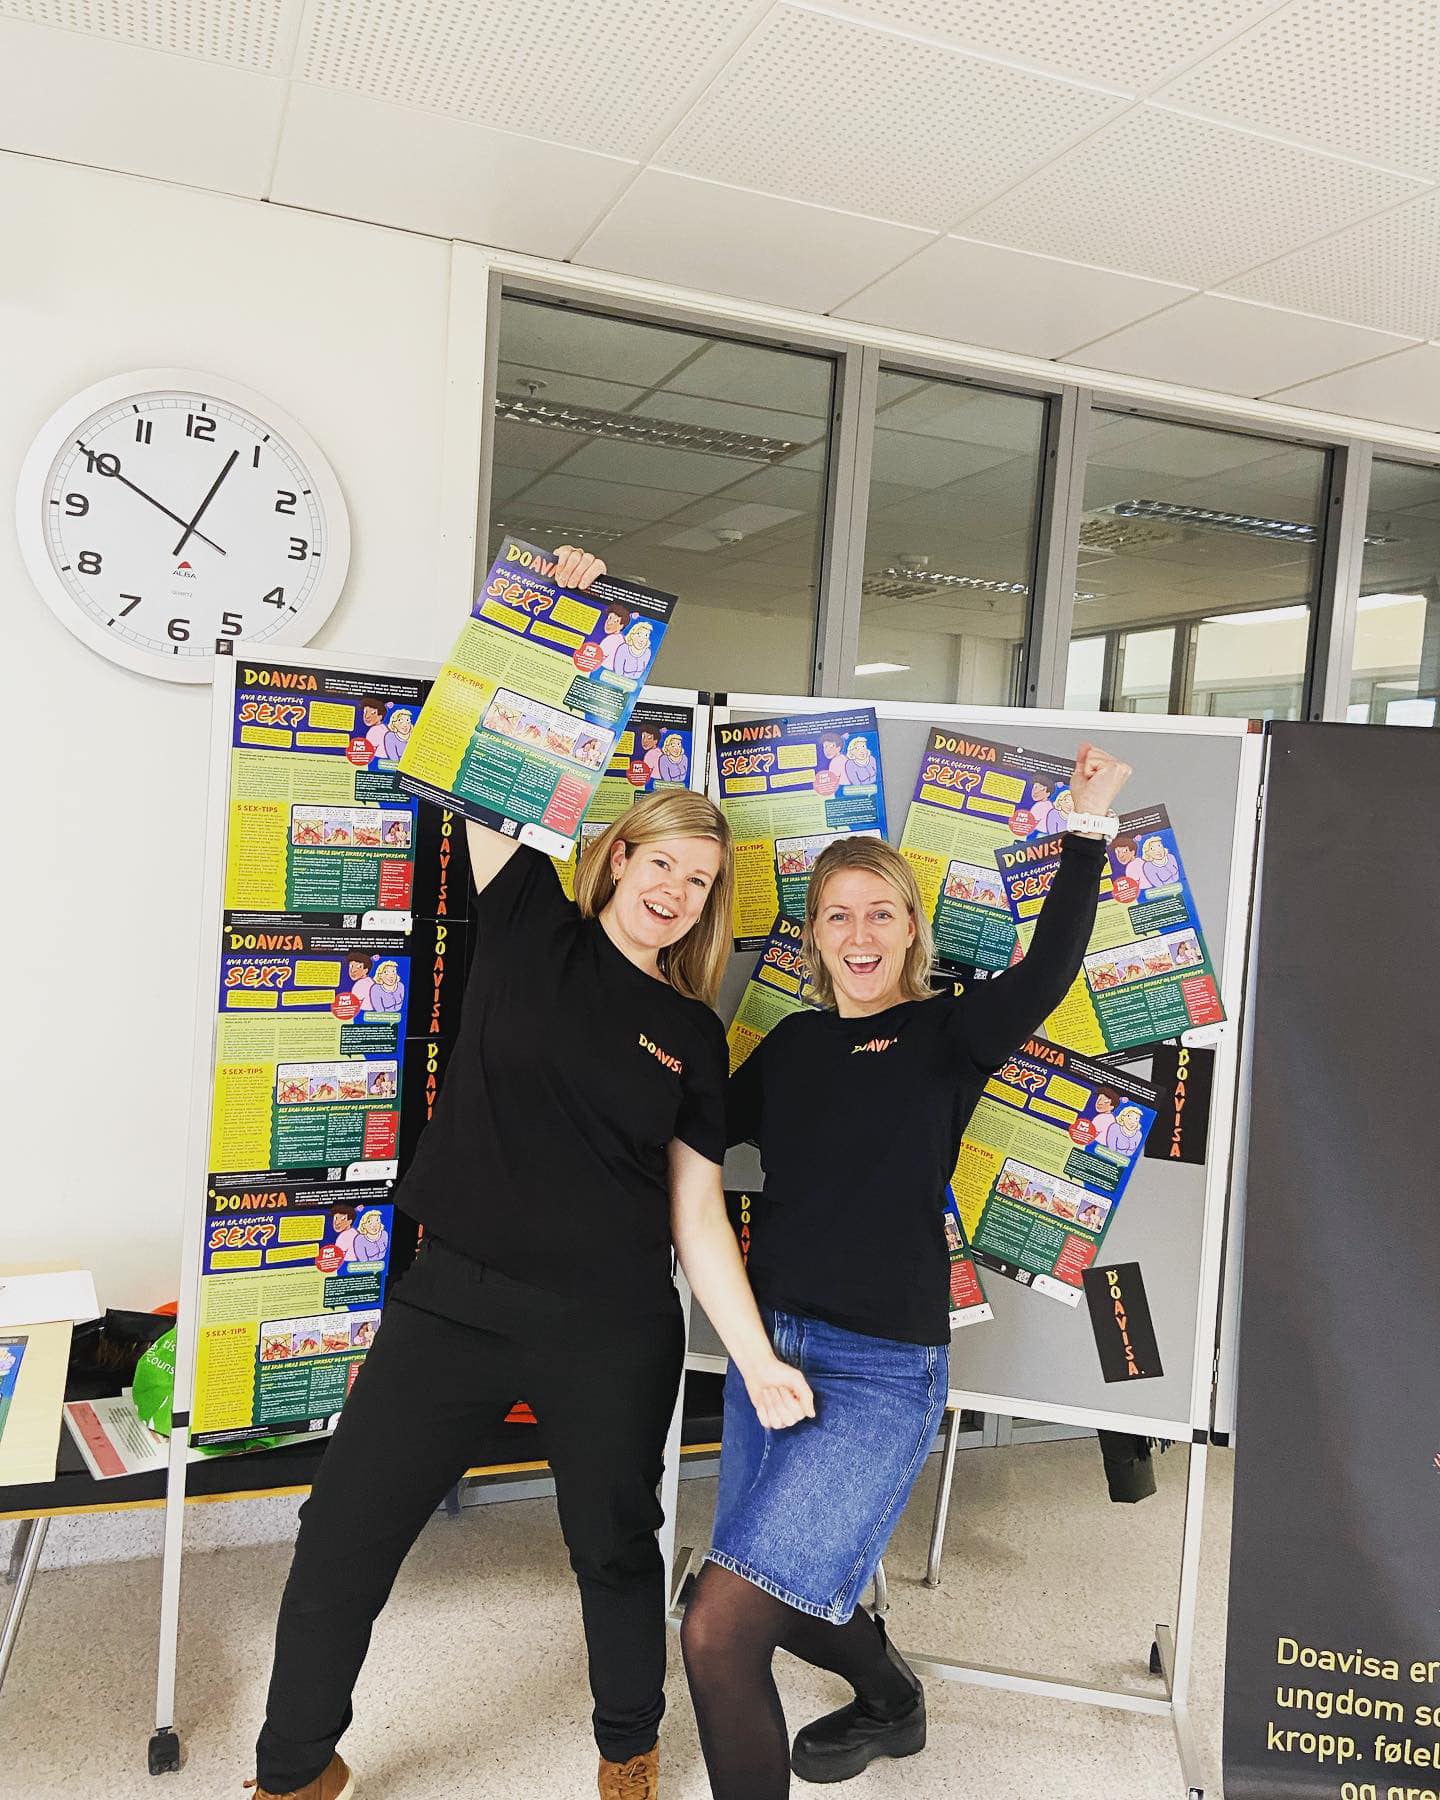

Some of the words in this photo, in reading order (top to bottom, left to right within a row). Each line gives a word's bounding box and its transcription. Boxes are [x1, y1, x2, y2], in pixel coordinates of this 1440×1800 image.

[136, 419, 153, 445] 11
[186, 414, 217, 443] 12
[86, 450, 122, 478] 10
[253, 445, 261, 468] 1
[65, 493, 90, 517] 9
[275, 490, 298, 515] 2
[288, 537, 309, 561] 3
[506, 544, 558, 578] DOAVI
[77, 550, 103, 576] 8
[119, 593, 142, 617] 7
[263, 586, 286, 609] 4
[487, 578, 554, 616] SEX?
[168, 618, 191, 642] 6
[221, 611, 243, 637] 5
[243, 668, 318, 691] DOAVISA
[238, 702, 307, 728] SEX?
[721, 724, 782, 744] DOAVISA
[934, 734, 998, 762] DOAVISA
[721, 753, 774, 776] SEX?
[922, 764, 981, 792] SEX?
[243, 805, 278, 813] SEX-TIPS
[1011, 869, 1058, 901] SEX
[229, 934, 304, 951] DOAVISA
[225, 966, 292, 989] SEX?
[429, 925, 448, 1033] DOAVISA
[1020, 1039, 1065, 1068] AVISA
[228, 1067, 263, 1075] SEX-TIPS
[426, 1042, 439, 1121] DOAVI
[1169, 1049, 1190, 1158] DOAVISA
[214, 1192, 288, 1212] DOAVISA
[208, 1224, 276, 1249] SEX?
[741, 1195, 751, 1266] DOAVI
[211, 1327, 247, 1337] SEX-TIPS
[1105, 1270, 1139, 1376] DOAVISA
[1277, 1637, 1399, 1681] Doavisa
[1409, 1661, 1440, 1683] er
[1276, 1686, 1404, 1723] ungdom
